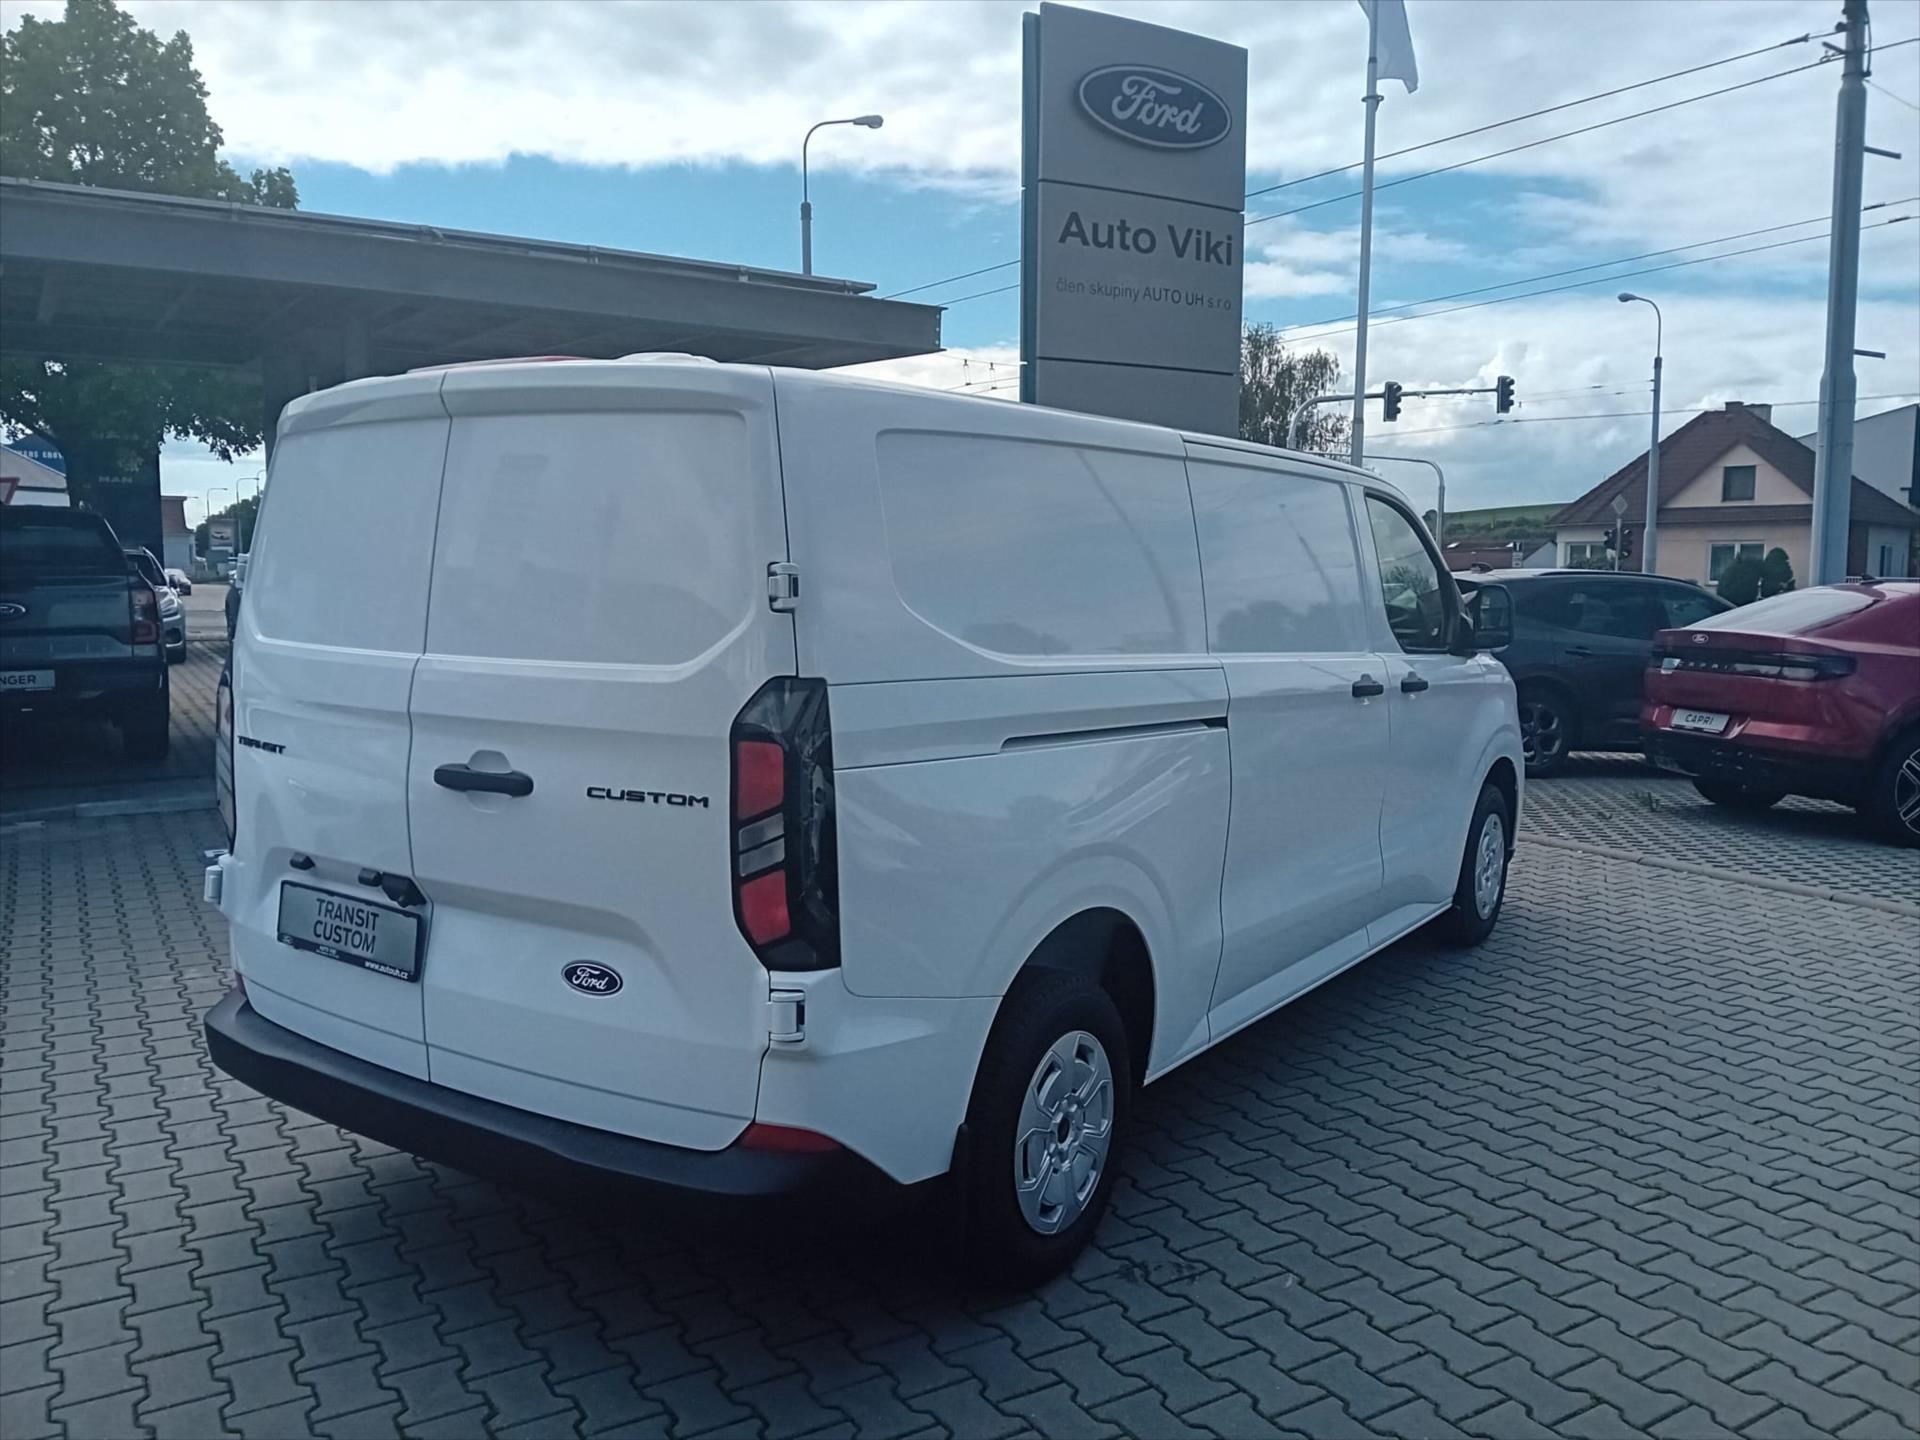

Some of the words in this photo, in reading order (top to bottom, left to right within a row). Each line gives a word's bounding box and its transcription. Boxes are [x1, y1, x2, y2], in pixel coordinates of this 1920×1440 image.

[1110, 75, 1205, 136] Ford
[1058, 210, 1157, 256] Auto
[1167, 223, 1233, 267] Viki
[1055, 276, 1086, 294] člen
[1089, 281, 1140, 303] skupiny
[1143, 285, 1182, 304] AUTO
[1185, 291, 1204, 307] UH
[1684, 713, 1715, 726] CAPRI
[586, 786, 710, 809] CUSTOM
[316, 898, 380, 932] TRANSIT
[313, 920, 377, 954] CUSTOM
[571, 965, 611, 991] Ford
